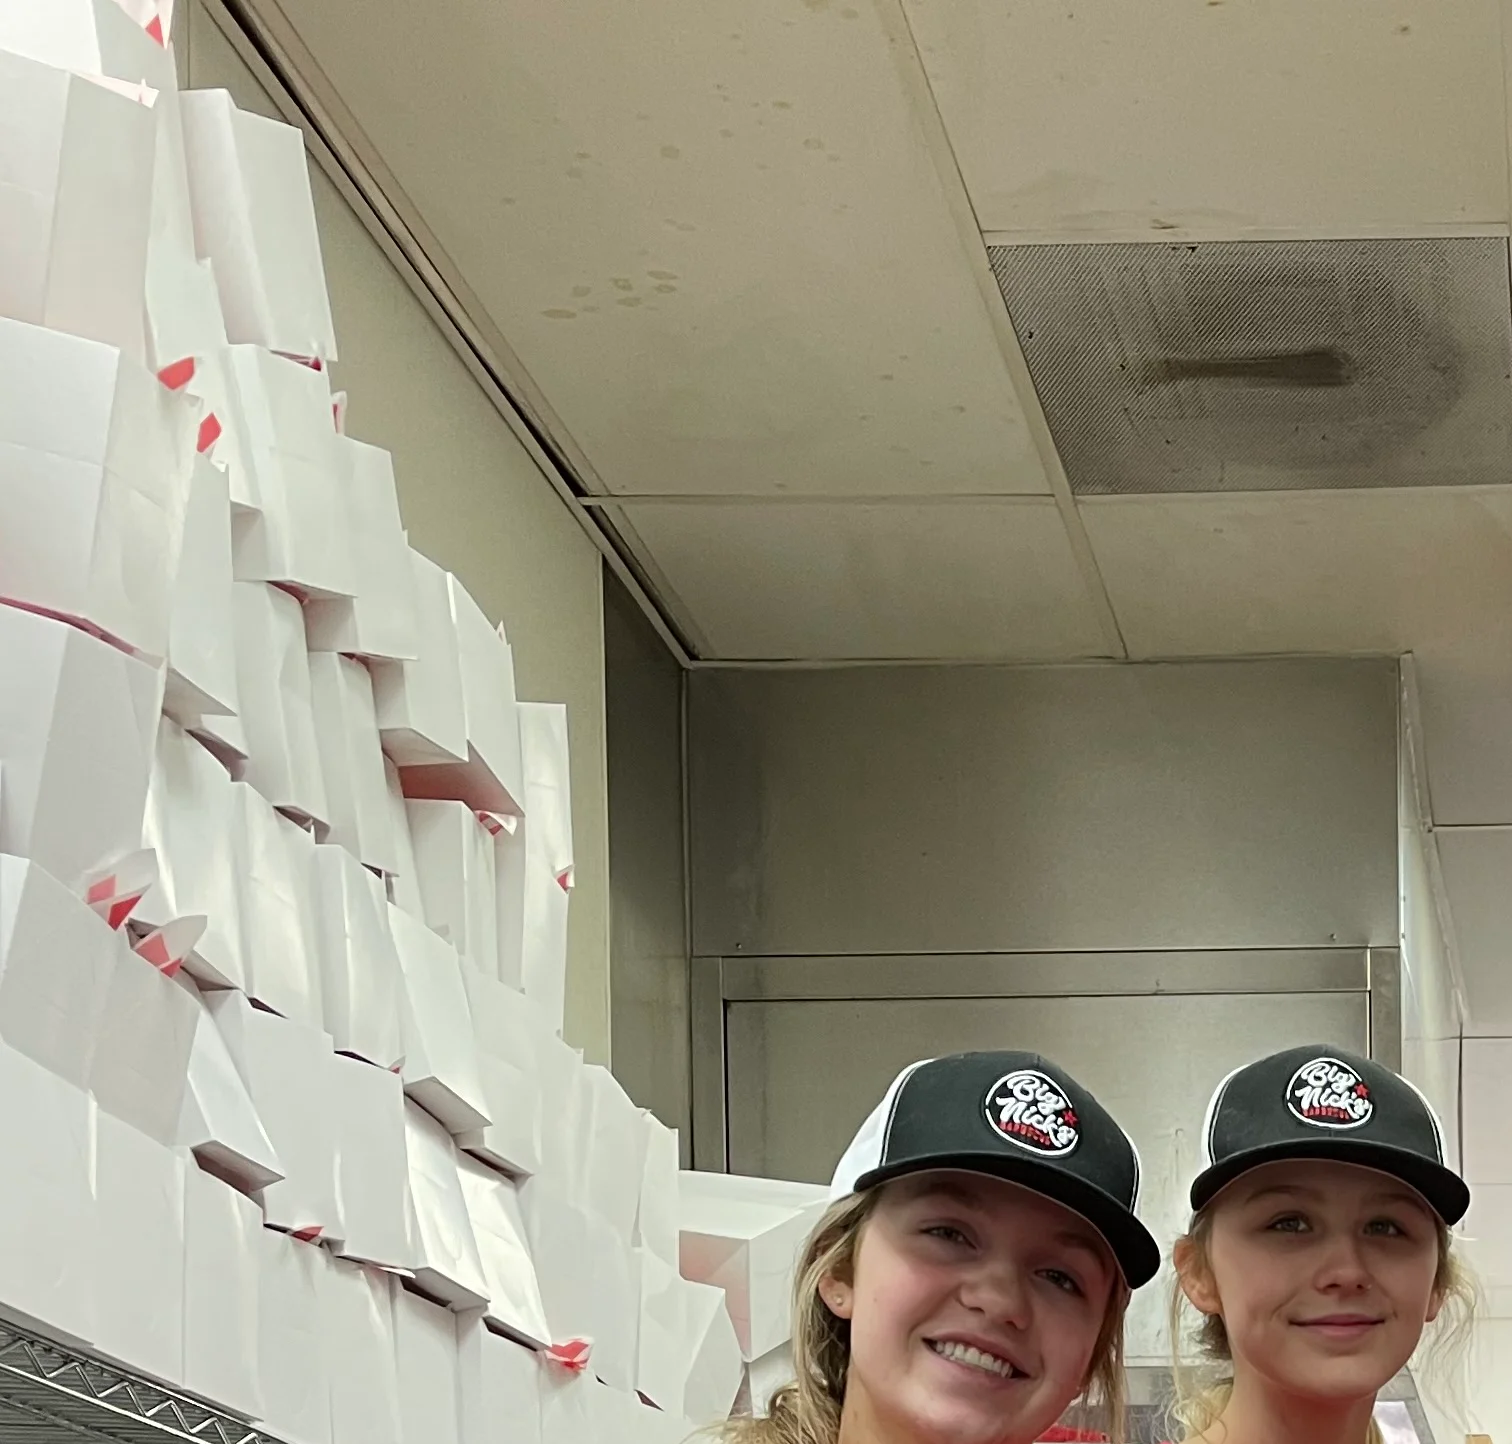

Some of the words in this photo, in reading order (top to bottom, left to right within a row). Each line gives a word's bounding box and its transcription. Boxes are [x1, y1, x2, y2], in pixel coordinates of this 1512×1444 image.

[1007, 1075, 1066, 1115] Big
[1301, 1062, 1356, 1094] Big
[1295, 1085, 1370, 1119] Nick's
[996, 1097, 1076, 1147] Nick's
